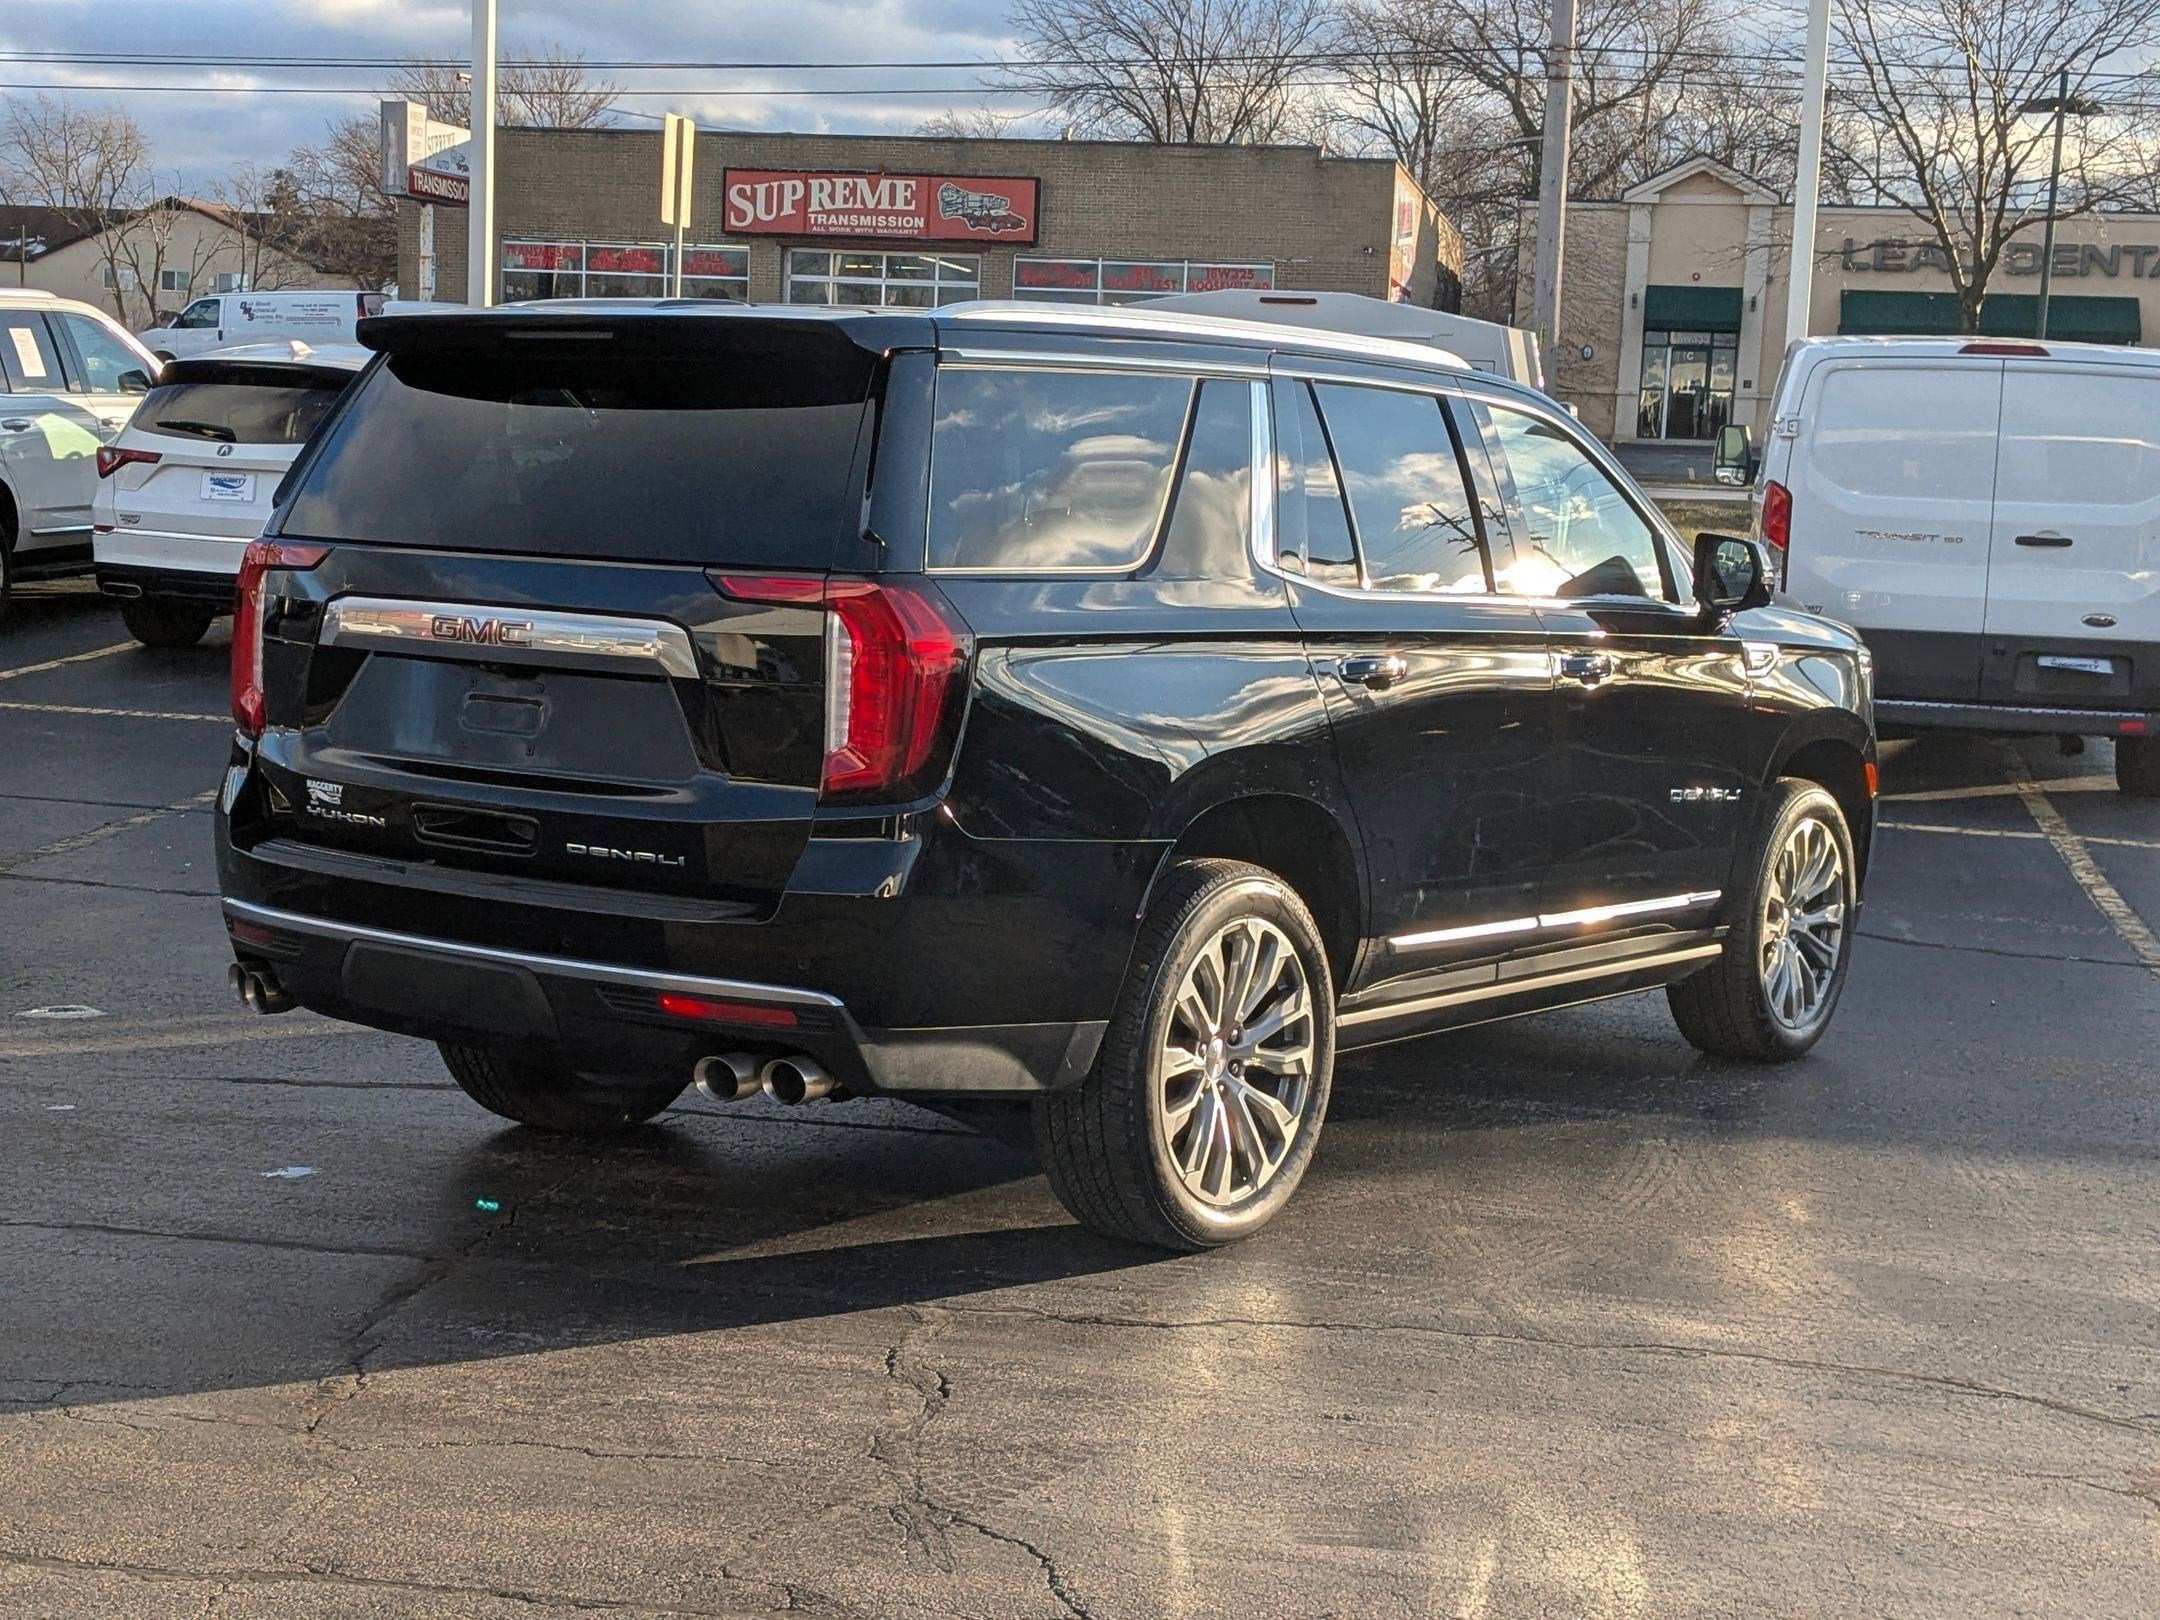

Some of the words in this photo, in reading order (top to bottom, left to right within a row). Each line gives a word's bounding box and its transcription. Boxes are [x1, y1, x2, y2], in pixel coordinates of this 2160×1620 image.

[729, 178, 916, 227] SUPREME
[808, 213, 925, 228] TRANSMISSION
[431, 615, 534, 648] GMC
[306, 805, 385, 827] YUKON
[566, 843, 685, 866] DENALI
